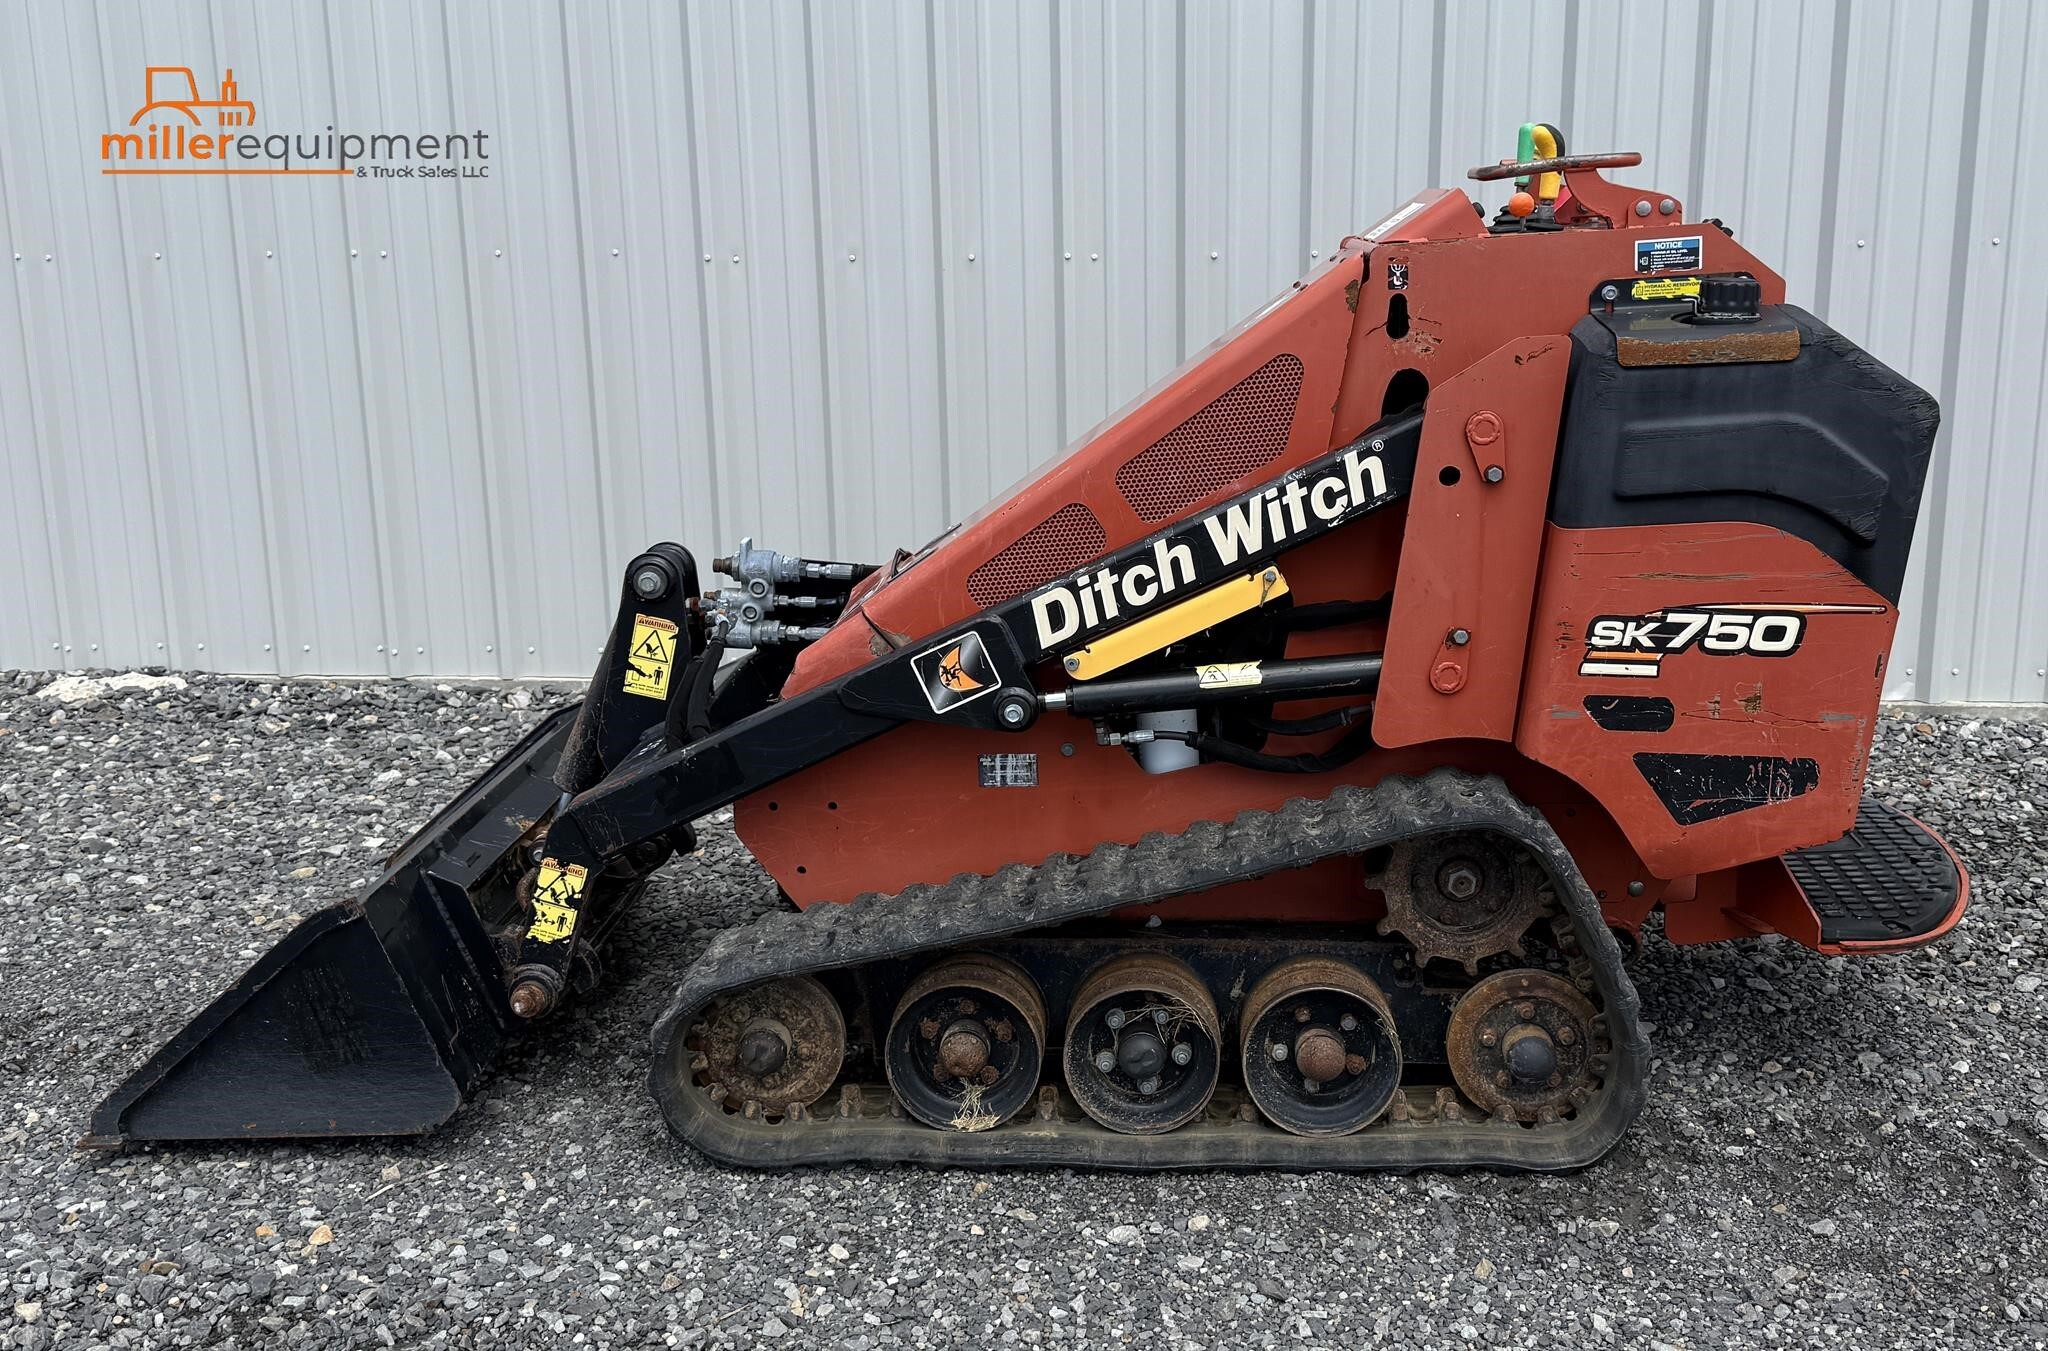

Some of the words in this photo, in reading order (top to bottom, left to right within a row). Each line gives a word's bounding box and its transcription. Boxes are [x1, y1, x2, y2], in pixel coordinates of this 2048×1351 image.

[1654, 241, 1683, 249] NOTICE
[1031, 538, 1197, 651] Ditch
[1204, 451, 1387, 567] Witch
[645, 618, 676, 631] WARNING
